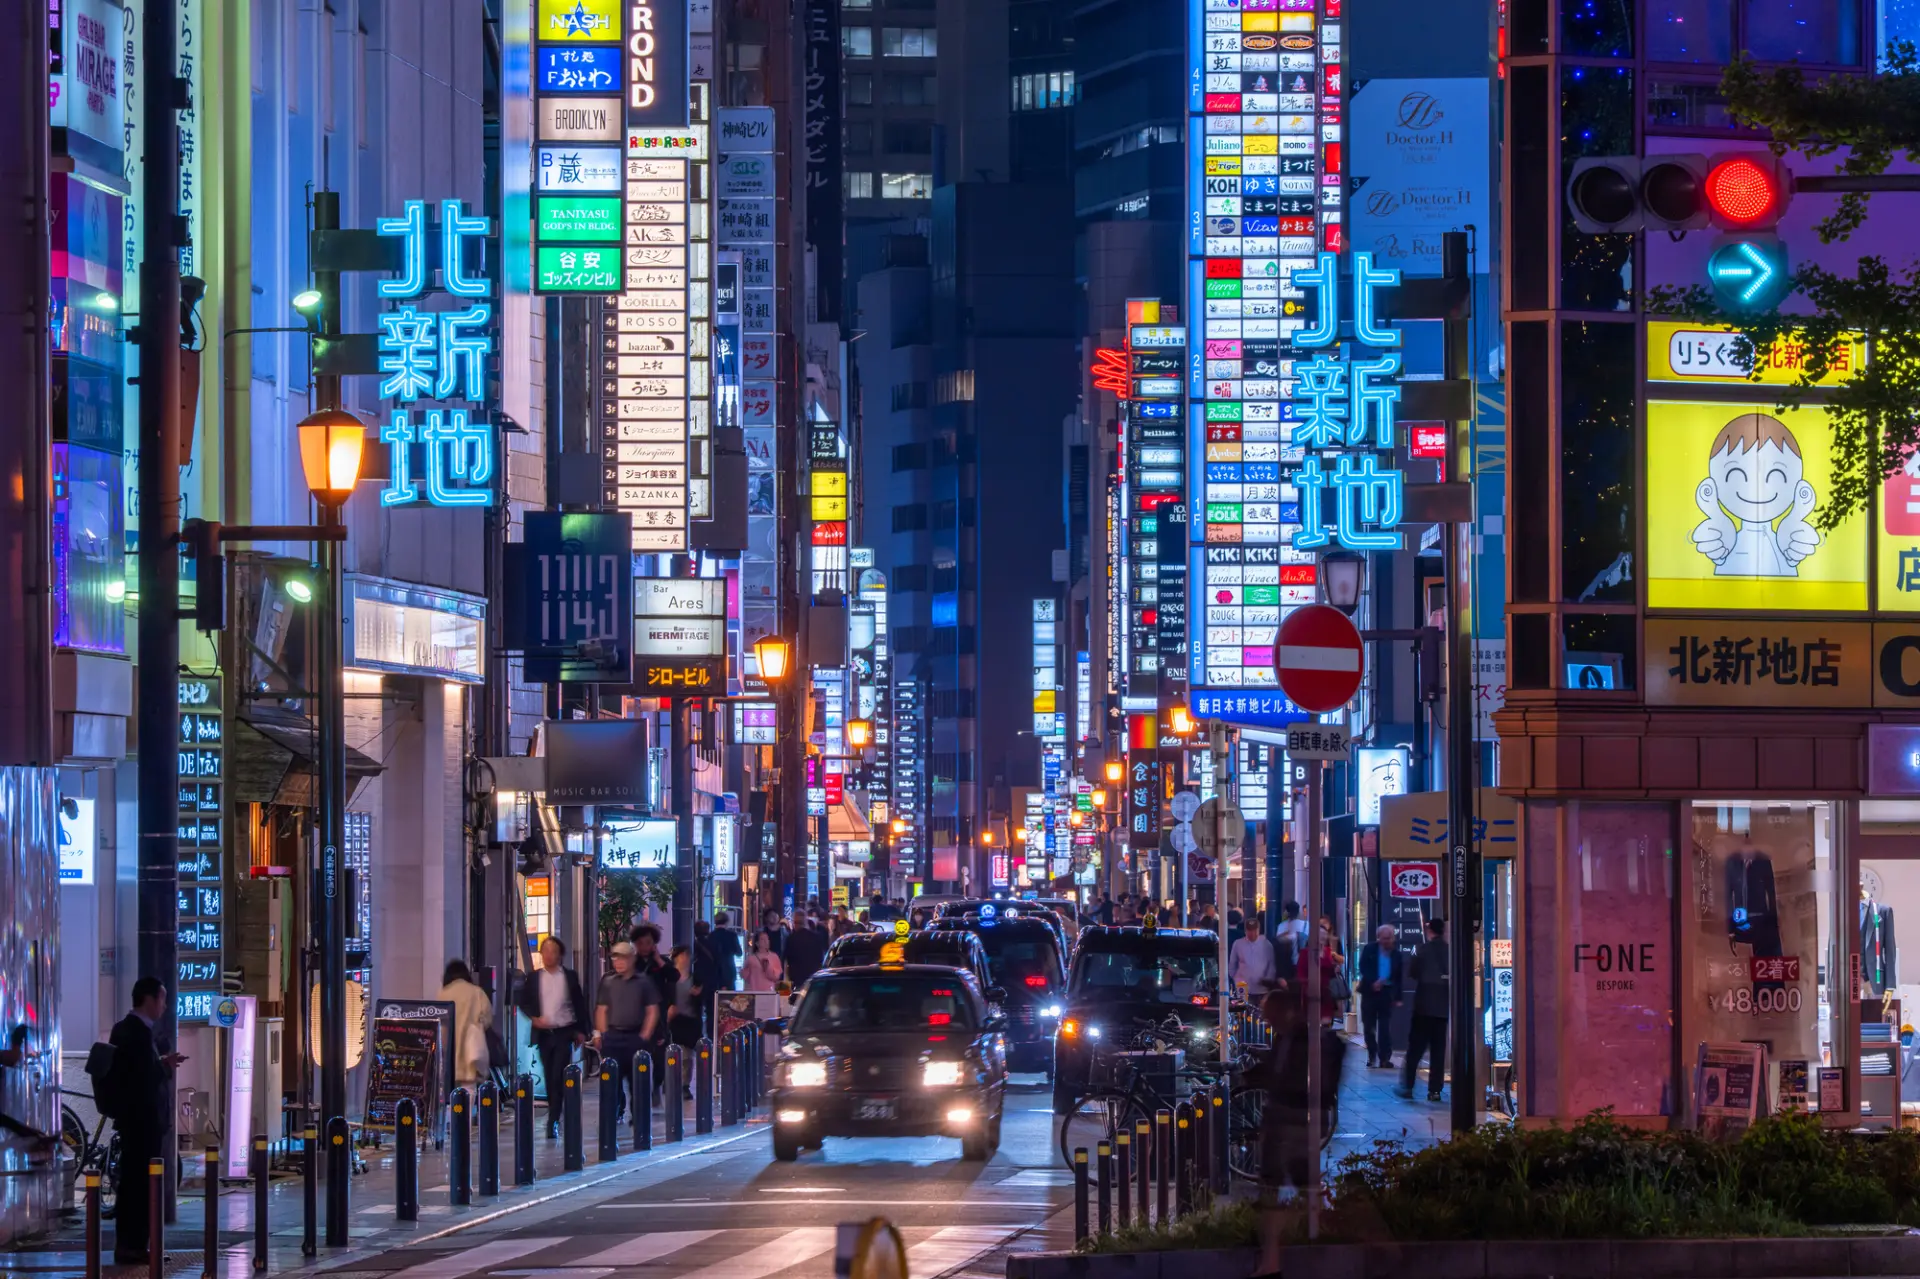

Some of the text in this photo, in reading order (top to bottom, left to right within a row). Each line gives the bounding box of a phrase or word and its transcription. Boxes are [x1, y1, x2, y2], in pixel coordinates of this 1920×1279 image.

[550, 13, 611, 29] NASH
[1212, 38, 1238, 51] 野原
[1213, 56, 1232, 71] 虹
[1245, 57, 1270, 68] BAR
[76, 40, 117, 98] MIRAGE
[558, 68, 612, 88] おとわ
[1213, 76, 1233, 88] りん
[1352, 81, 1361, 91] 4
[555, 109, 606, 130] BROOKLYN
[722, 120, 769, 138] 神崎ビル
[1385, 131, 1453, 145] Doctor.H
[1206, 139, 1240, 150] Juliano
[558, 152, 584, 184] 蔵
[1218, 162, 1241, 170] Tiger
[1207, 179, 1238, 193] KOH
[1245, 177, 1277, 193] ゆき
[1283, 180, 1313, 190] NOTANI
[1352, 178, 1360, 189] 3
[1401, 190, 1471, 205] Doctor.H
[1244, 201, 1277, 212] こまつ
[1281, 201, 1313, 212] こまつ
[551, 209, 609, 219] TANIYASU
[722, 212, 770, 228] 神崎組
[543, 222, 572, 231] GOD'S
[588, 223, 617, 231] BLDG.
[1281, 220, 1315, 232] かおる
[1282, 240, 1313, 251] Trinity
[559, 251, 601, 270] 谷安
[543, 272, 616, 286] ゴッズインビル
[1207, 282, 1237, 291] tierra
[624, 298, 678, 307] GORILLA
[1253, 306, 1277, 315] セレネ
[605, 317, 677, 326] 4F ROSSO
[605, 340, 661, 351] 4F bazaar
[377, 199, 492, 507] 北新地
[605, 361, 616, 370] 4F
[605, 383, 616, 392] 4F
[1291, 251, 1402, 551] 北新地
[605, 405, 616, 413] 3F
[1143, 405, 1179, 416] 七つ星
[605, 427, 616, 435] 3F
[605, 449, 616, 457] 2F
[605, 469, 677, 479] 2F ジョイ美容室
[606, 490, 679, 499] 1F SAZANKA
[1246, 486, 1277, 500] 月波
[1207, 510, 1240, 520] FOLK
[653, 585, 668, 593] Bar
[668, 596, 704, 609] Ares
[1211, 609, 1236, 620] ROUGE
[649, 632, 709, 640] HERMITAGE
[1669, 636, 1842, 685] 北新地店
[648, 667, 710, 686] ジロービル
[1288, 732, 1349, 753] 自転車を除く
[553, 787, 610, 796] MUSIC BAR
[608, 844, 669, 867] 神田川
[1398, 873, 1430, 888] たばこ
[200, 933, 219, 948] マリモ
[1574, 943, 1655, 973] FONE
[1755, 958, 1799, 980] 2着で
[1596, 980, 1635, 991] BESPOKE
